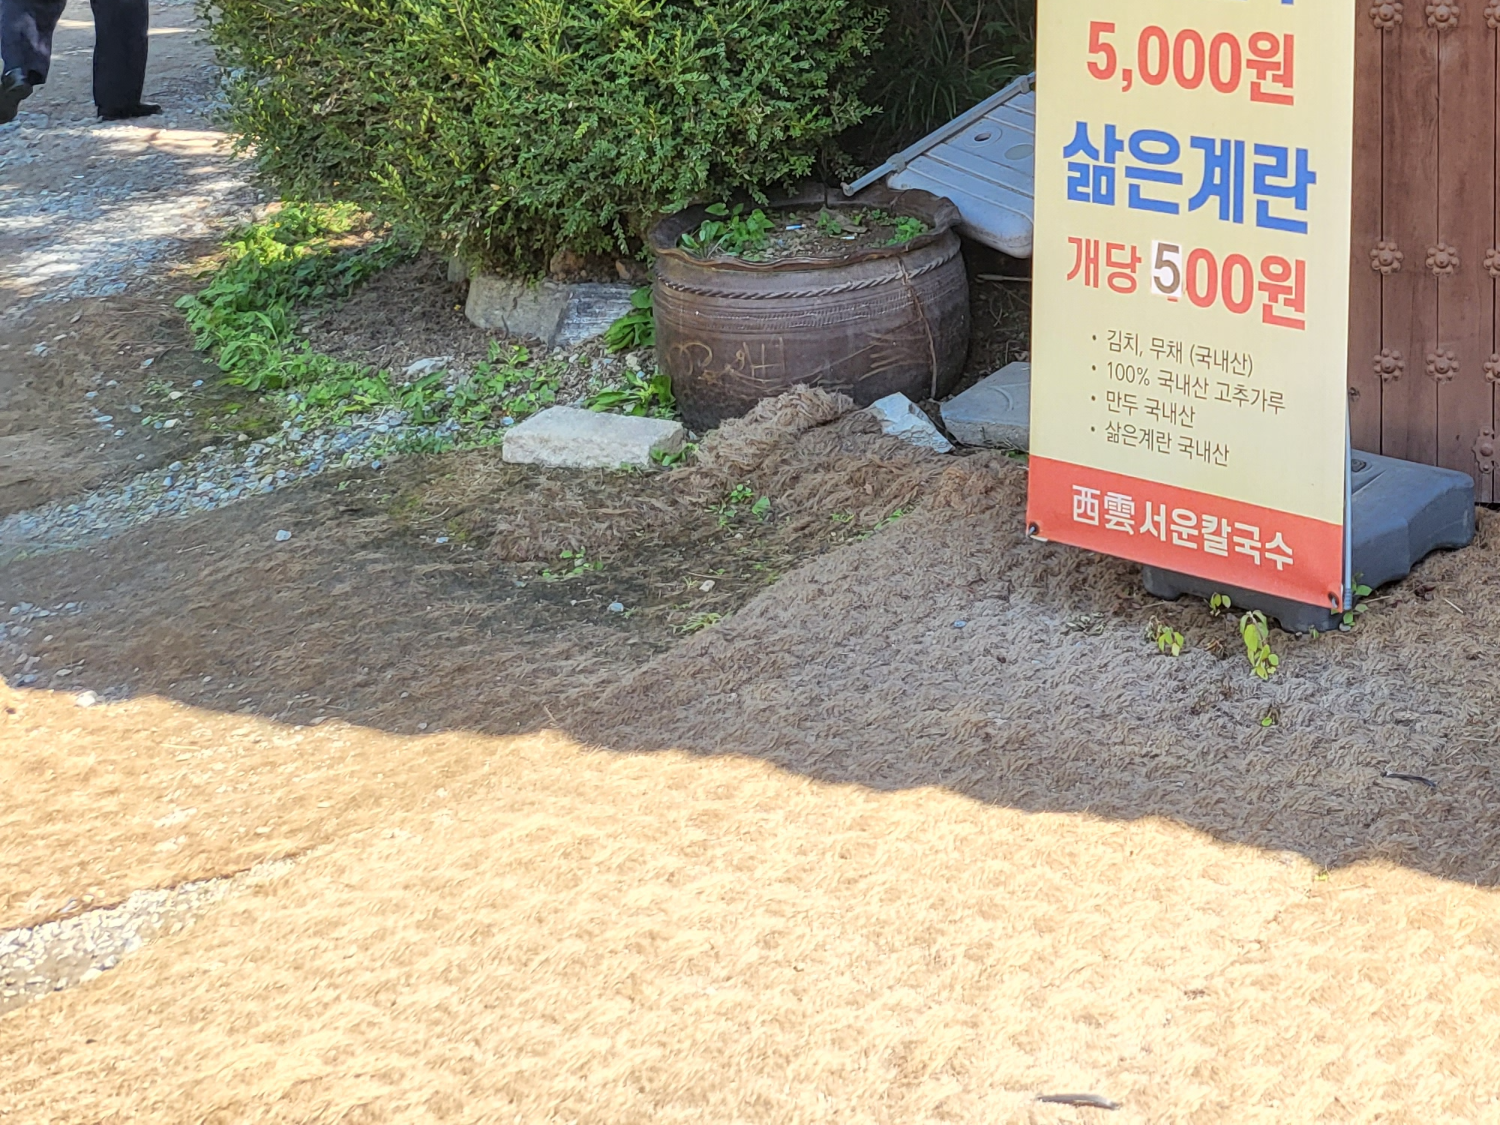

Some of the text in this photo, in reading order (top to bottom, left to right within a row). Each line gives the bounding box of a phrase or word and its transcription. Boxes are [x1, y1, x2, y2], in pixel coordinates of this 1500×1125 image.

[1086, 20, 1295, 106] 5,000원
[1063, 120, 1317, 235] 삶은계란
[1066, 236, 1306, 331] 개당 500원
[1106, 329, 1254, 377] 김치, 무채 (국내산)
[1105, 390, 1196, 428] 만두 국내산
[1106, 361, 1286, 415] 100% 국내산 고추가루
[1105, 420, 1230, 467] 삶은계란 국내산
